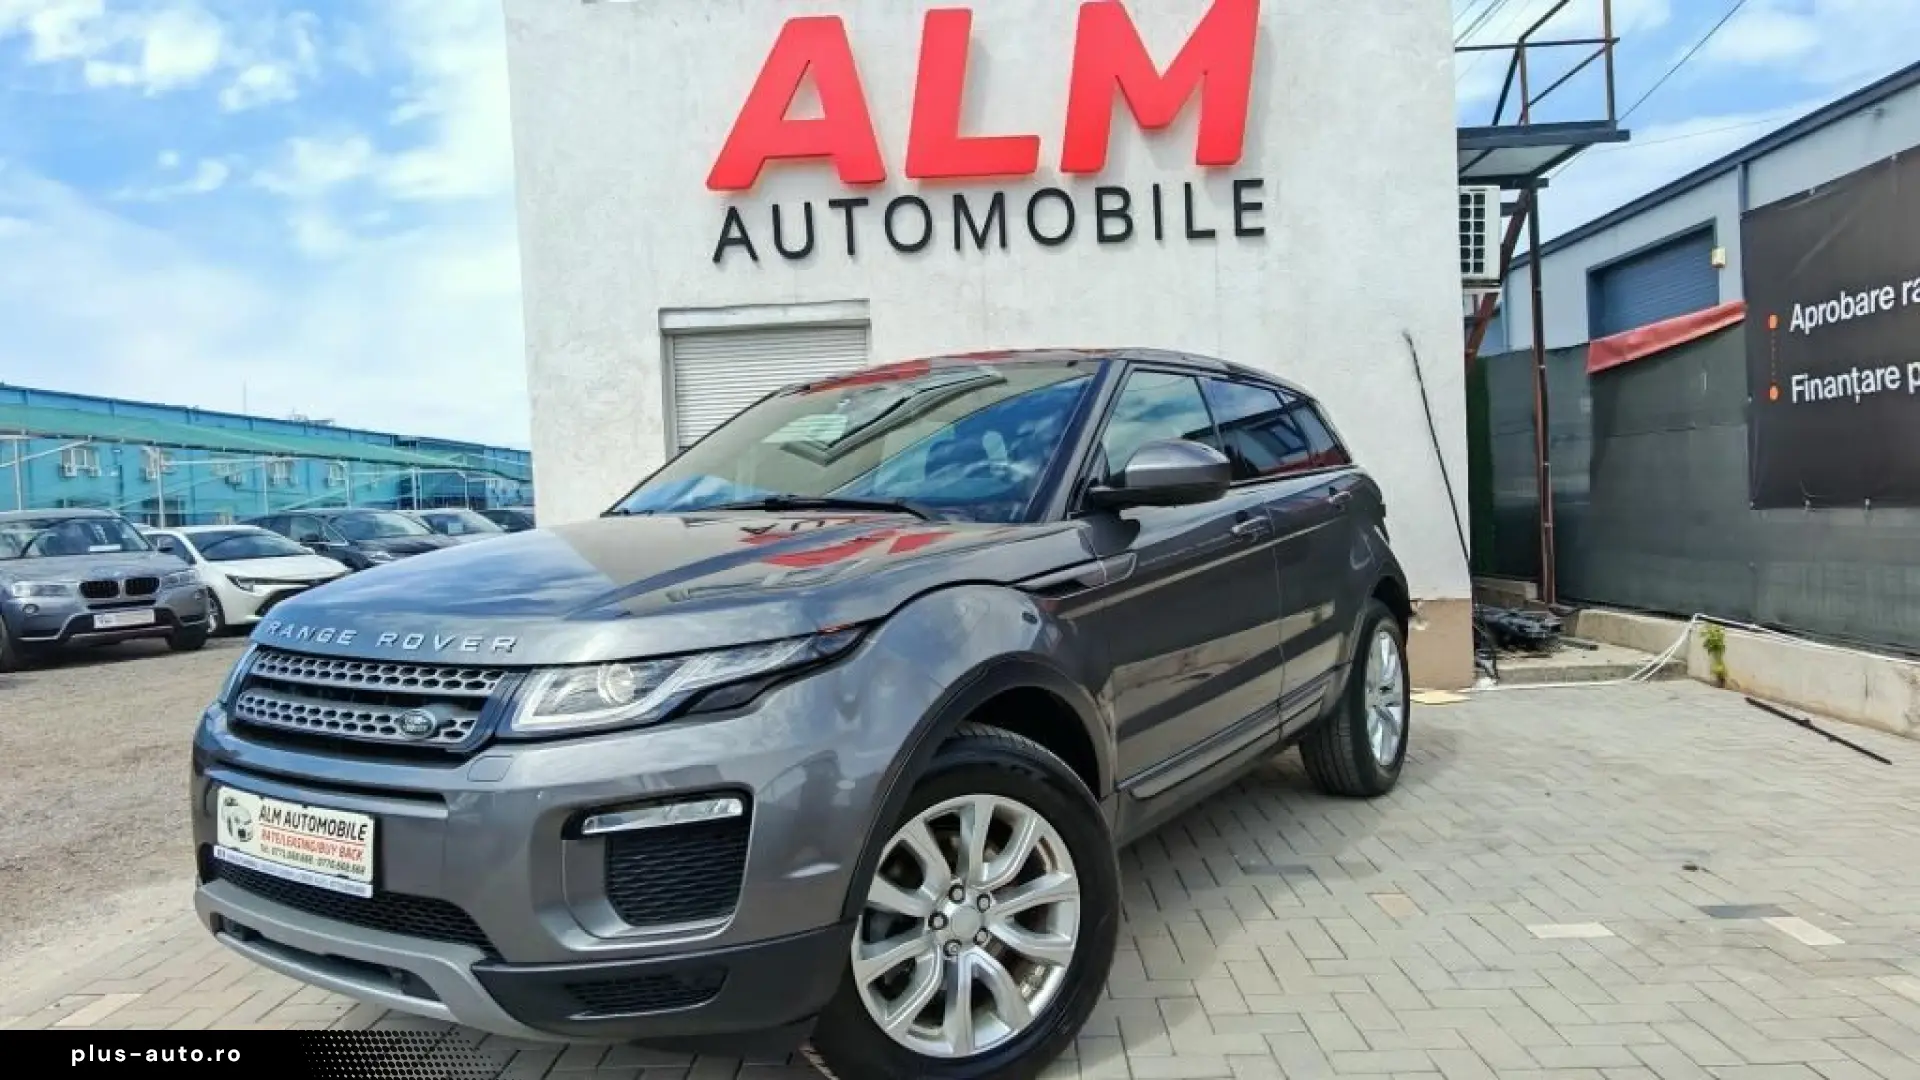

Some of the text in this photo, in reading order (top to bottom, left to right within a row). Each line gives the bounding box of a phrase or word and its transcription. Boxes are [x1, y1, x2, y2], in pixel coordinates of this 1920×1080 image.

[705, 0, 1260, 191] ALM
[712, 178, 1266, 264] AUTOMOBILE
[1789, 284, 1895, 335] Aprobare
[1791, 365, 1901, 404] Finanțare
[265, 620, 518, 654] RANGE ROVER
[259, 805, 368, 841] ALM AUTOMOBILE
[339, 845, 364, 862] BACK
